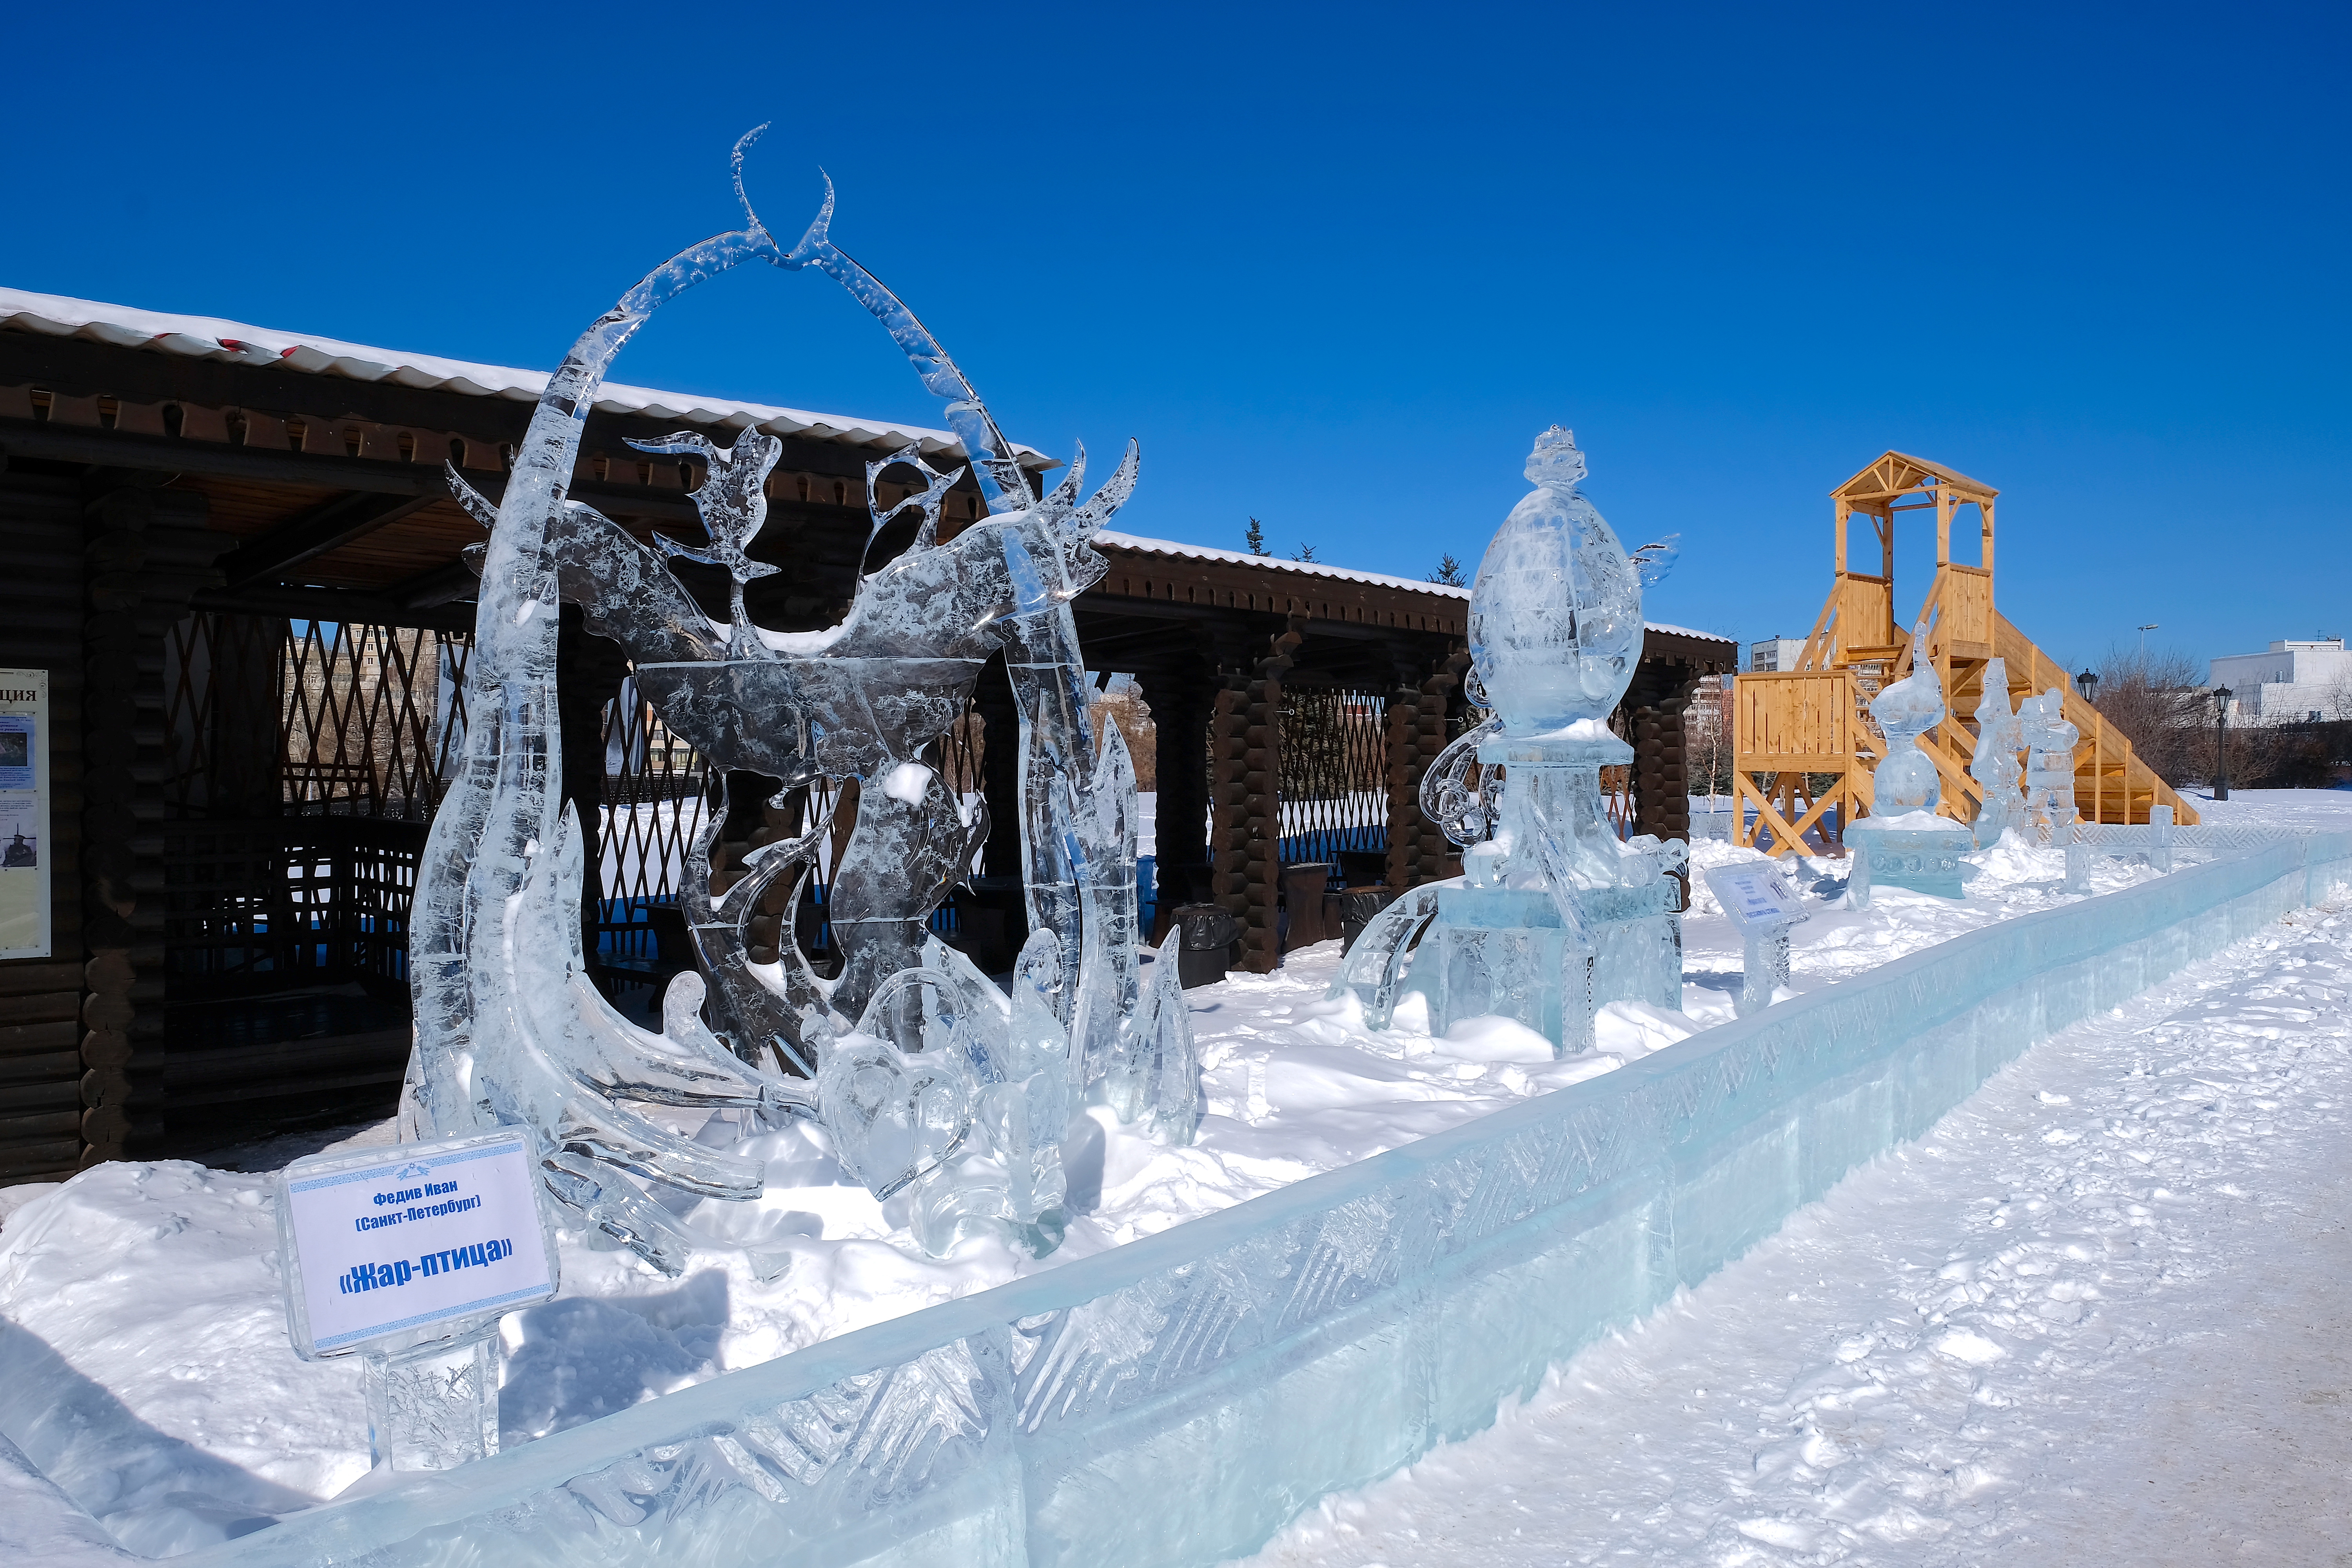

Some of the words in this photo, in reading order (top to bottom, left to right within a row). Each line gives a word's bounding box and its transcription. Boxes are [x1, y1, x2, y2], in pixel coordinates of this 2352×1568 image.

[373, 1188, 423, 1206] Федив
[424, 1180, 458, 1197] Иван
[355, 1194, 481, 1232] (Санкт-Петербург)
[339, 1238, 513, 1294] «Жар-птица»
